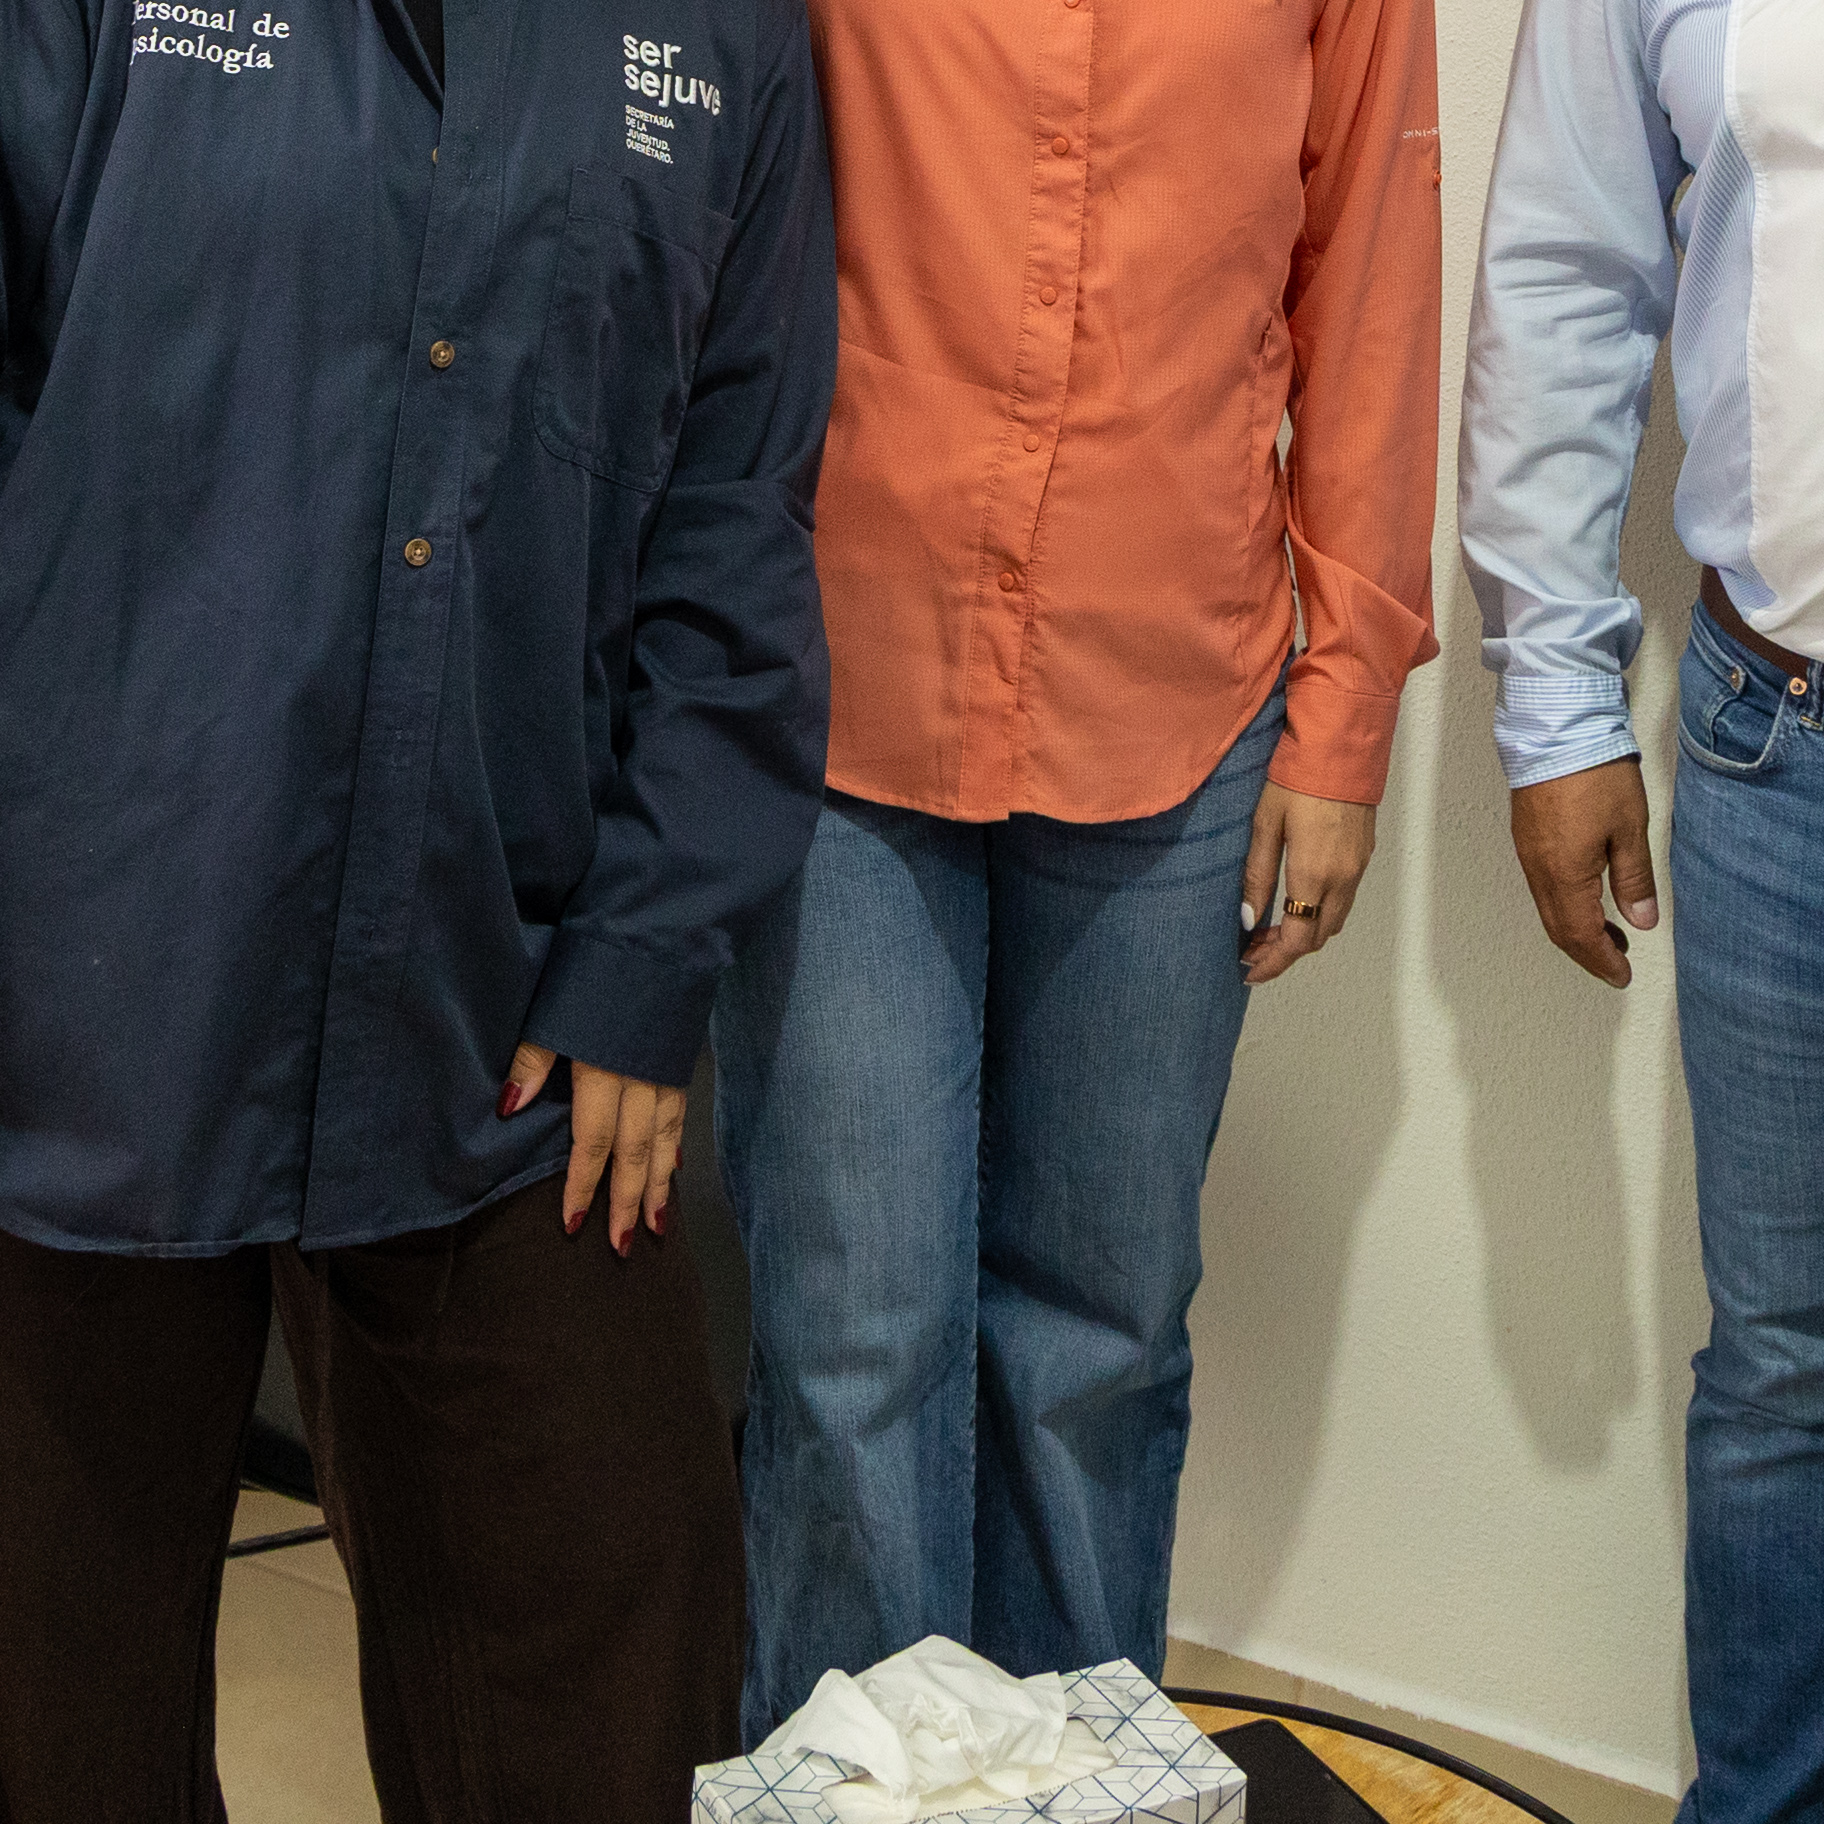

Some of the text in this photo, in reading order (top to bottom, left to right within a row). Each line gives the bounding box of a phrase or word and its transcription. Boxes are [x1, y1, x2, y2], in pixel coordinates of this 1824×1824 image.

[252, 13, 290, 39] de
[623, 34, 682, 69] ser
[624, 63, 722, 116] sejuve
[625, 105, 674, 129] SECRETARÍA
[626, 115, 647, 132] DE LA
[626, 128, 670, 151] JUVENTUD.
[626, 138, 673, 164] QUERÉTARO.
